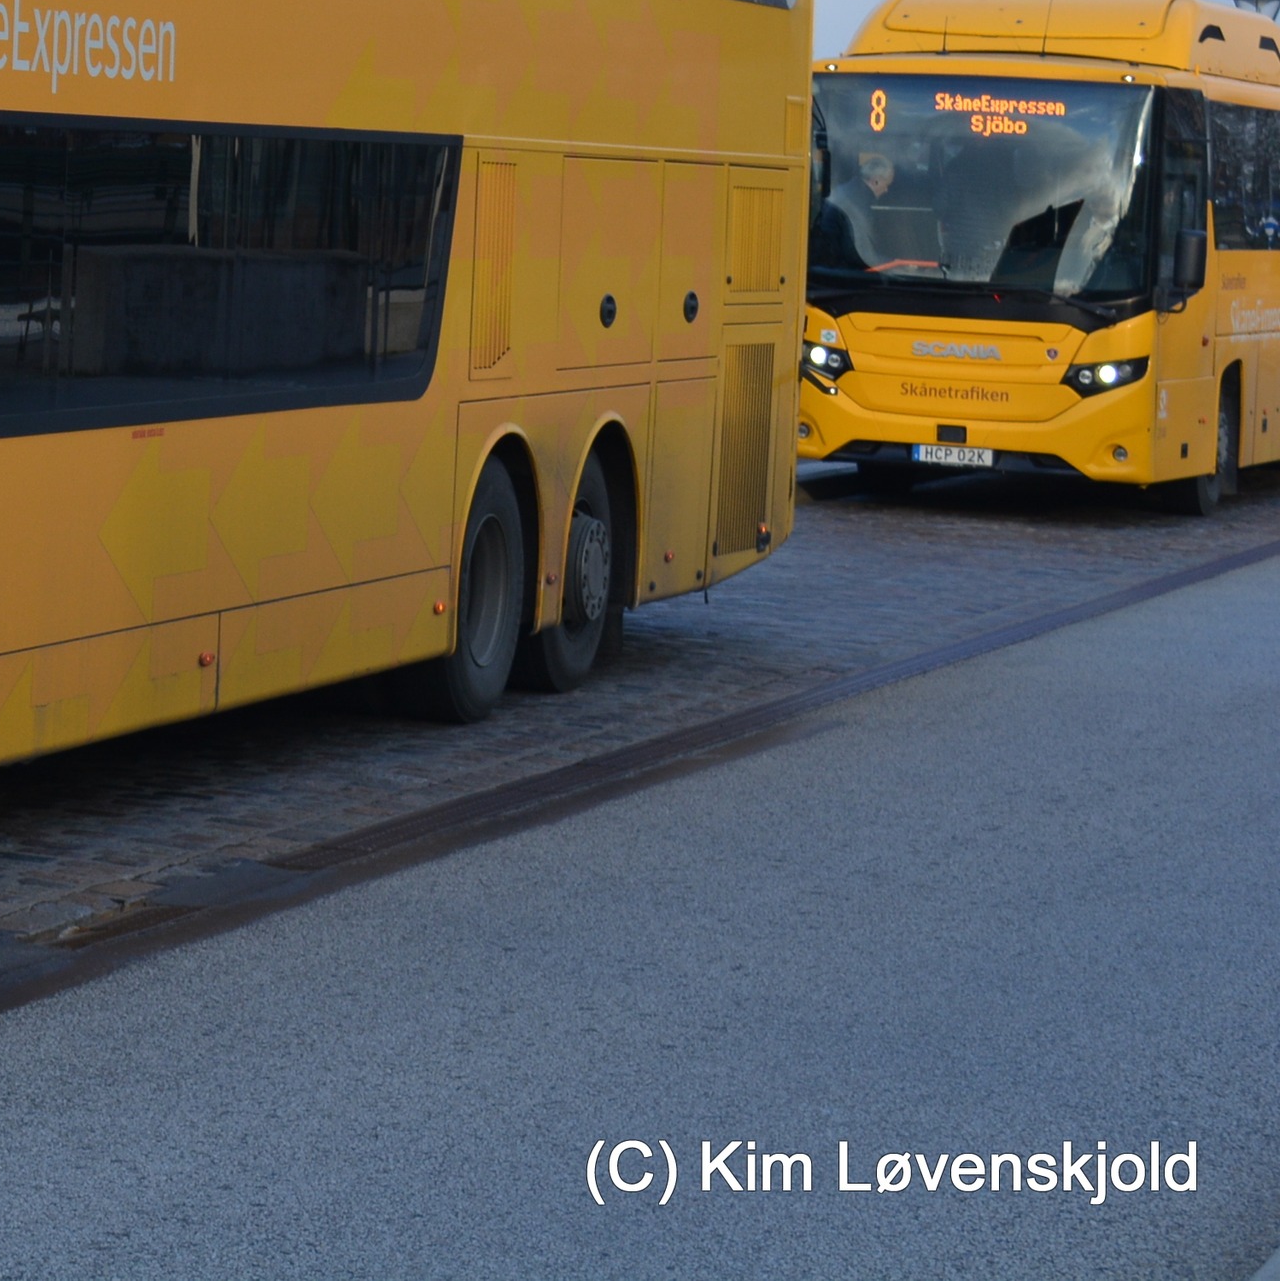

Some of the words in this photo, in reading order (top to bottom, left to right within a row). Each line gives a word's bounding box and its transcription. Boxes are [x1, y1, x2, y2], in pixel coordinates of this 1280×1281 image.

[870, 89, 886, 131] 8
[934, 92, 1066, 116] SkåneExpressen
[970, 115, 1028, 137] Sjöbo
[911, 340, 1002, 360] SCANIA
[900, 382, 1009, 402] Skånetrafiken
[924, 446, 953, 461] HCP
[957, 449, 985, 464] 02K
